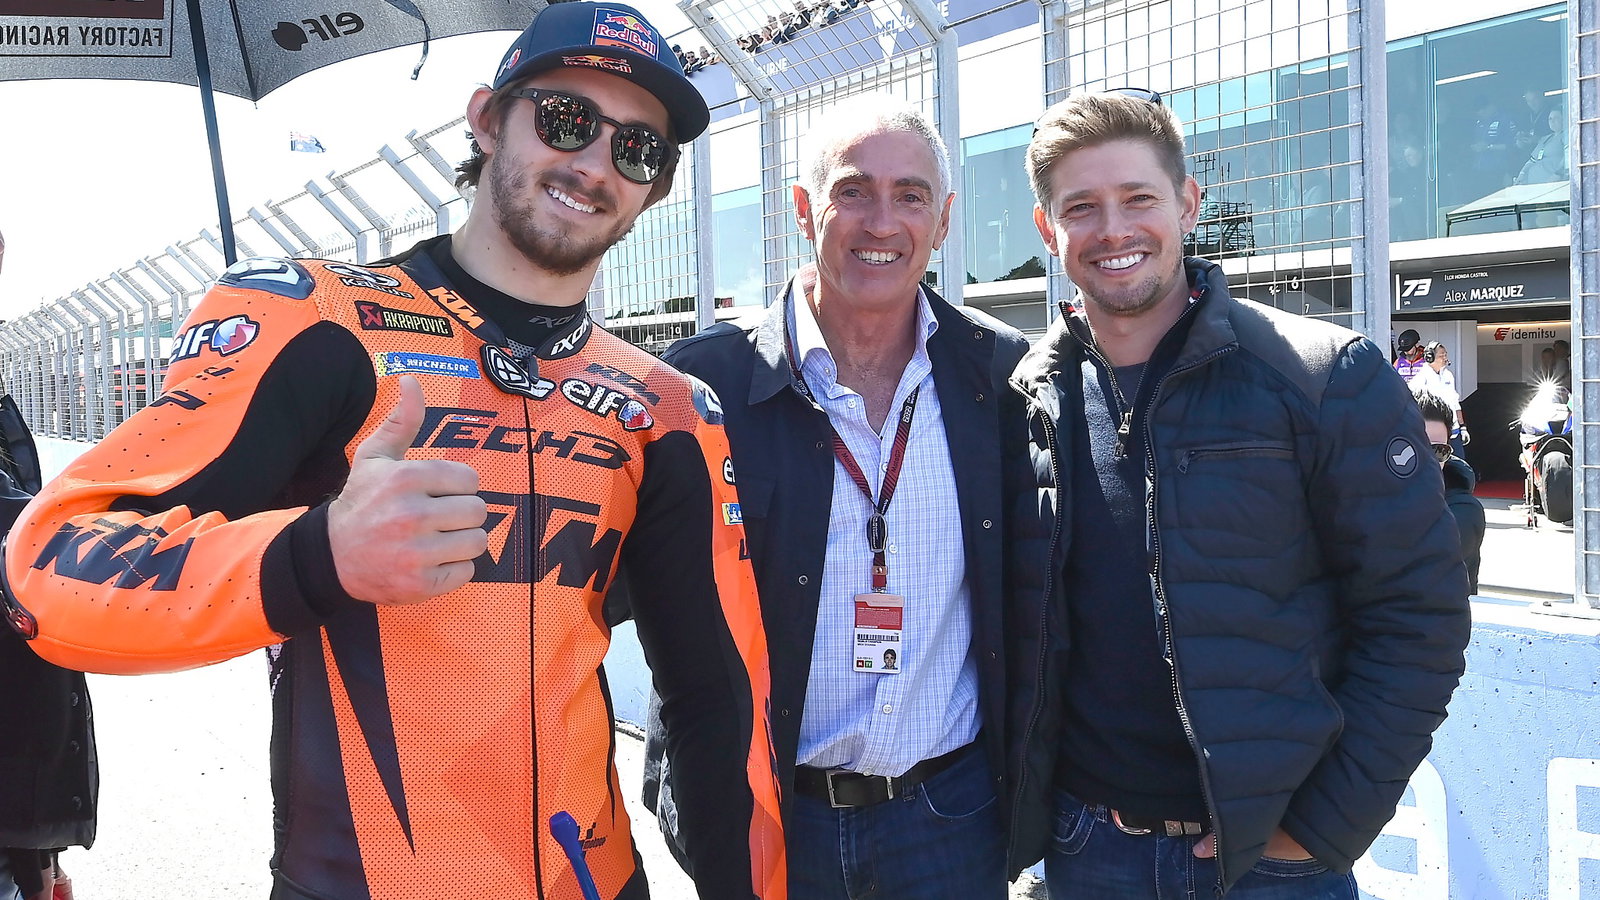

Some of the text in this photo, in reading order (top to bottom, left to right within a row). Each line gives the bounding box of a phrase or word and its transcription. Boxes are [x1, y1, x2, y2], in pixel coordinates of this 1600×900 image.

[596, 24, 657, 56] Red Bull
[1291, 276, 1299, 289] 6
[1401, 278, 1432, 297] 73
[1444, 284, 1524, 302] Alex MARQUEZ
[427, 286, 485, 329] KTM
[669, 326, 681, 335] 10
[1511, 327, 1556, 340] idemitsu
[406, 358, 470, 372] MICHELIN
[561, 379, 626, 415] elf
[32, 518, 196, 591] KTM
